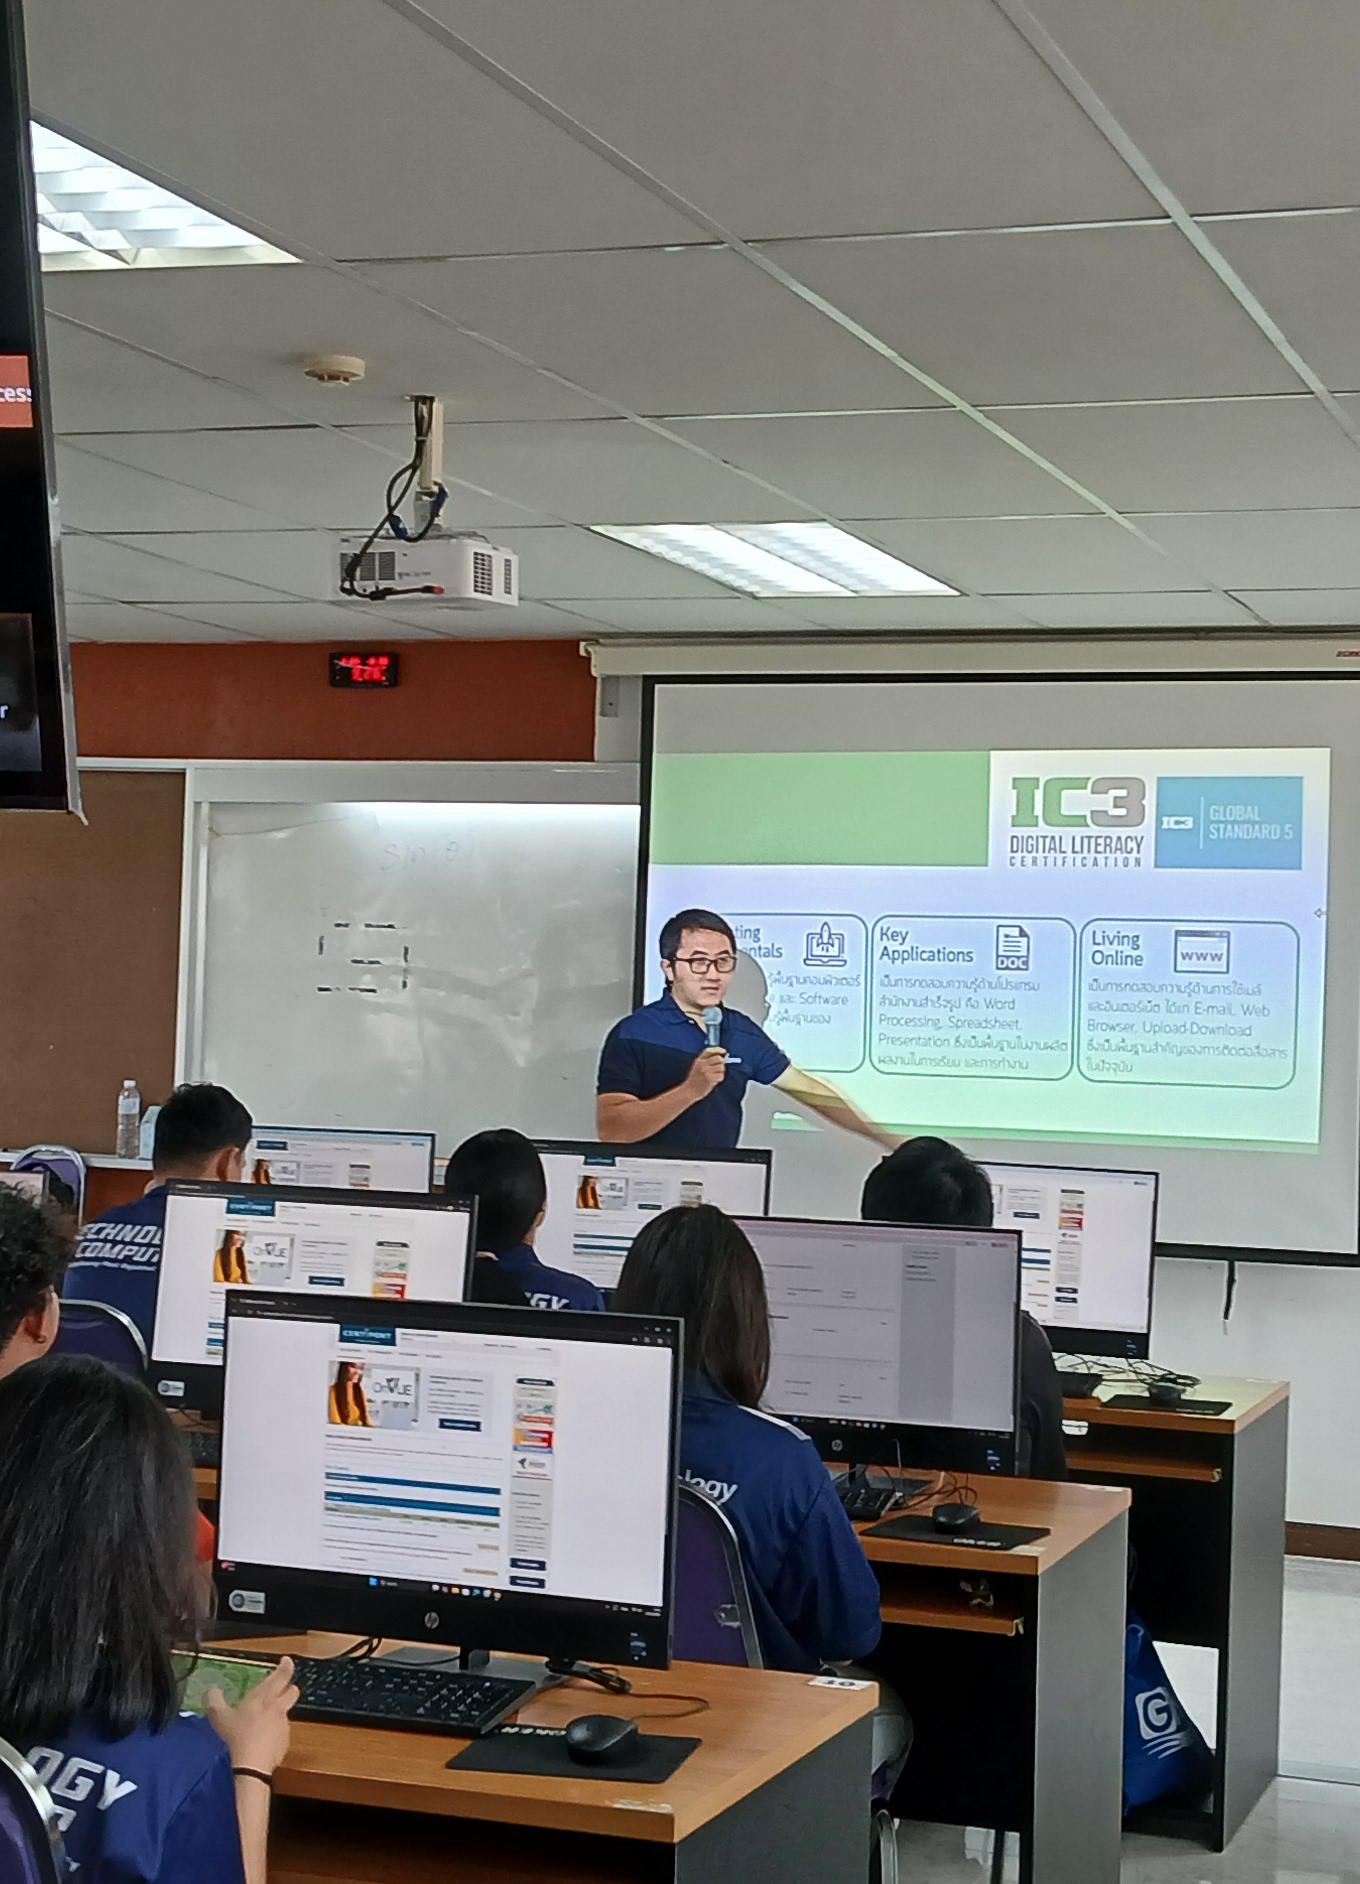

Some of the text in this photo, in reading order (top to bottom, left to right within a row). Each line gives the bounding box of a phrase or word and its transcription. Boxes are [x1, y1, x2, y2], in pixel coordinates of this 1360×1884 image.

[1011, 776, 1146, 828] IC3
[1209, 805, 1260, 822] GLOBAL
[1161, 816, 1193, 830] IC3
[1209, 824, 1293, 841] STANDARD 5
[1010, 835, 1144, 855] DIGITAL LITERACY
[1009, 856, 1142, 868] CERTIFICATION
[880, 927, 908, 945] Key
[1092, 931, 1140, 950] Living
[879, 947, 973, 964] Applications
[998, 957, 1027, 969] DOC
[1092, 951, 1143, 966] Online
[800, 992, 848, 1005] Software
[984, 998, 1015, 1010] Word
[1241, 1004, 1270, 1017] Web
[1143, 1021, 1252, 1037] Upload-Download
[878, 1033, 950, 1047] Presentation
